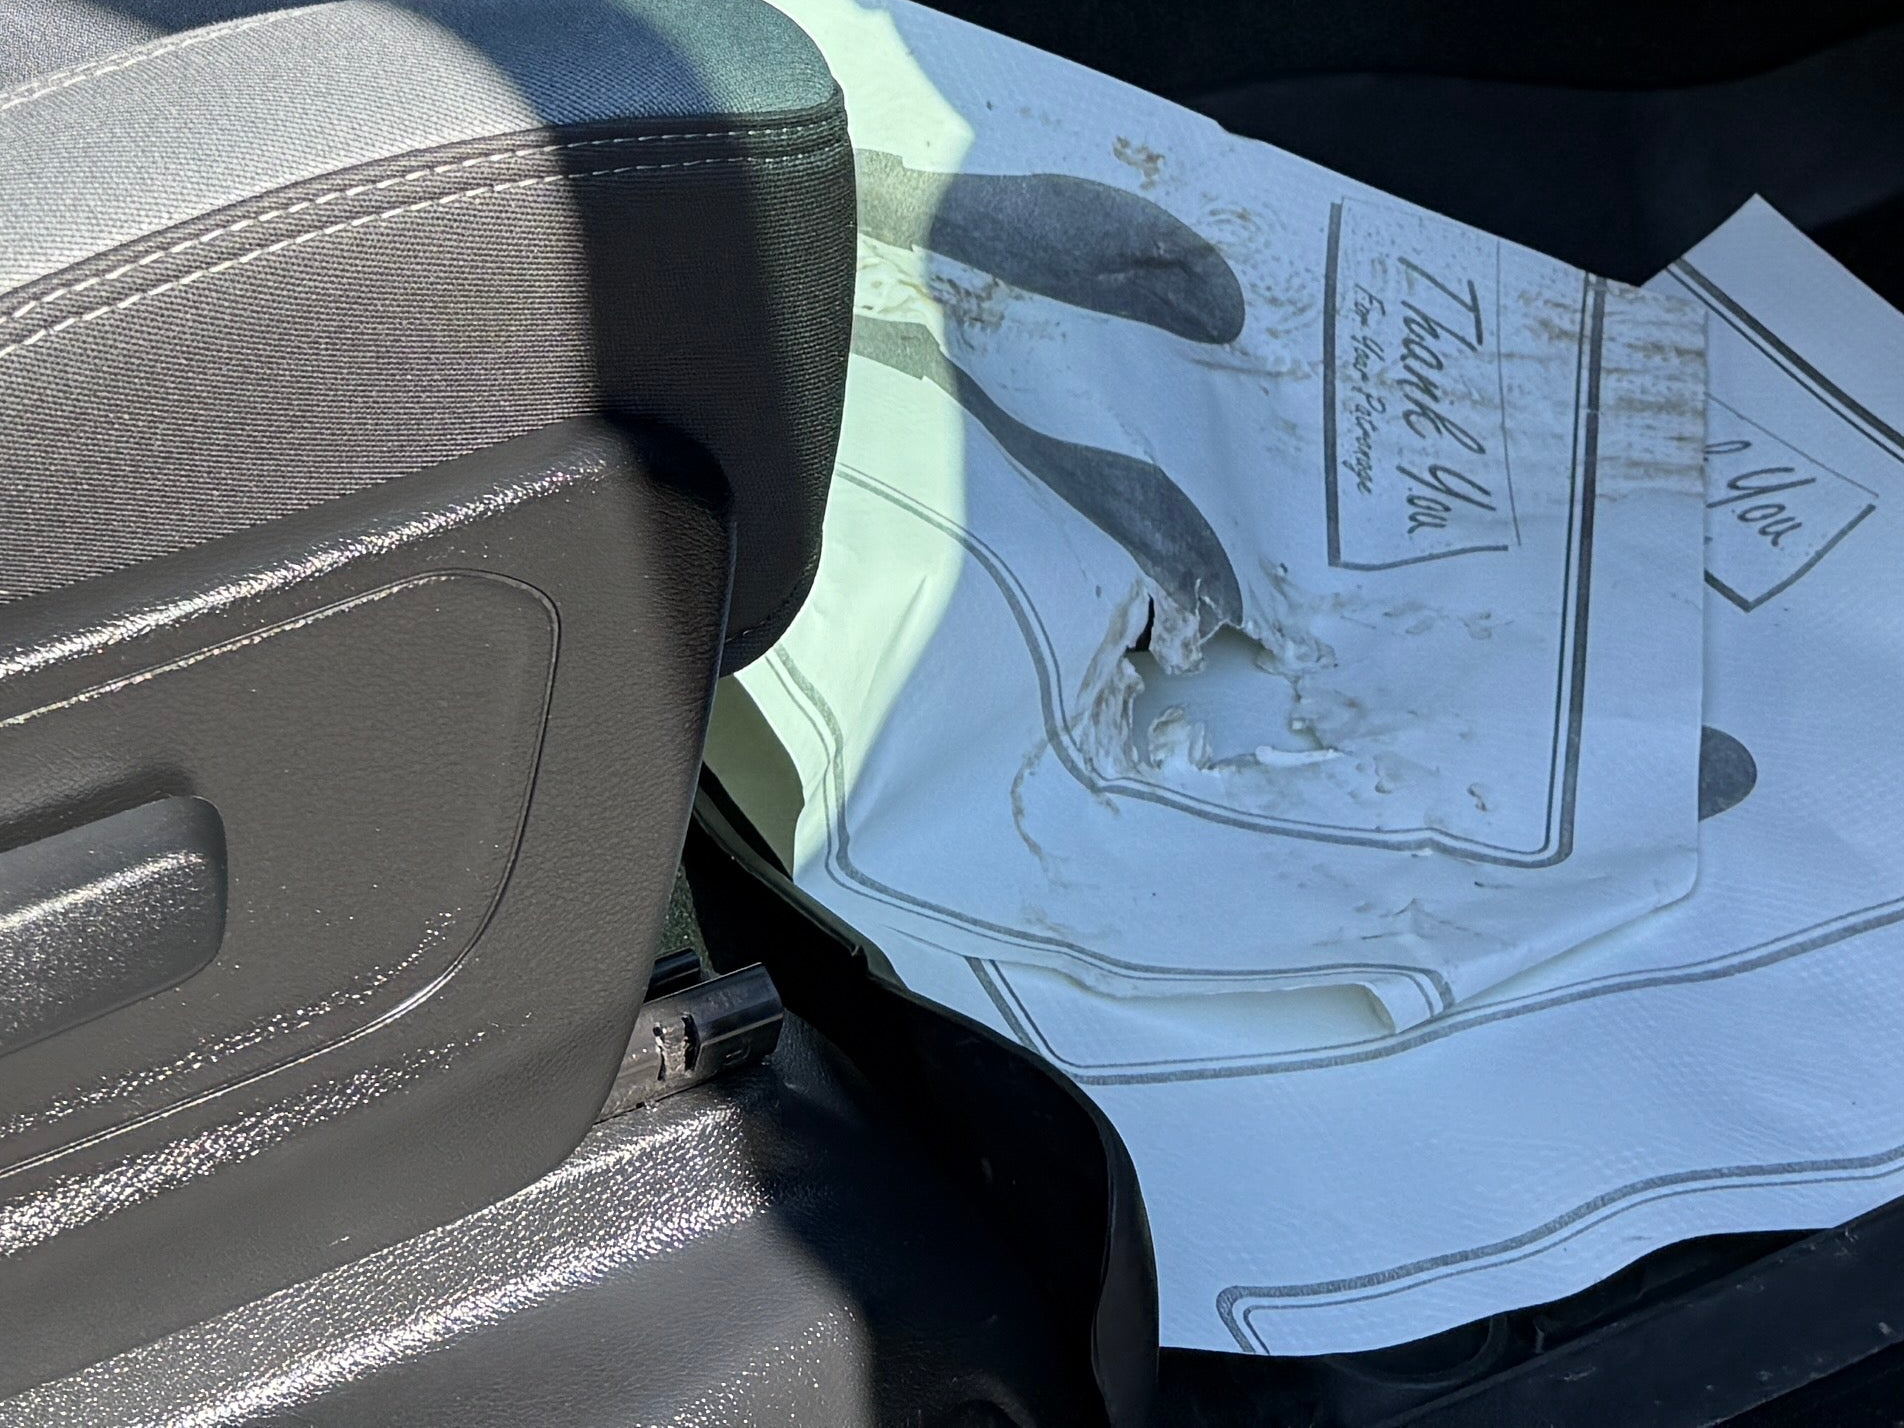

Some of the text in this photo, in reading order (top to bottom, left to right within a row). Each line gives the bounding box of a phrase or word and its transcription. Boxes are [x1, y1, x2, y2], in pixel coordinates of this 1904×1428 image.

[1342, 284, 1388, 494] For Your Patronage
[1396, 256, 1496, 535] Thank You
[1706, 466, 1816, 547] You
